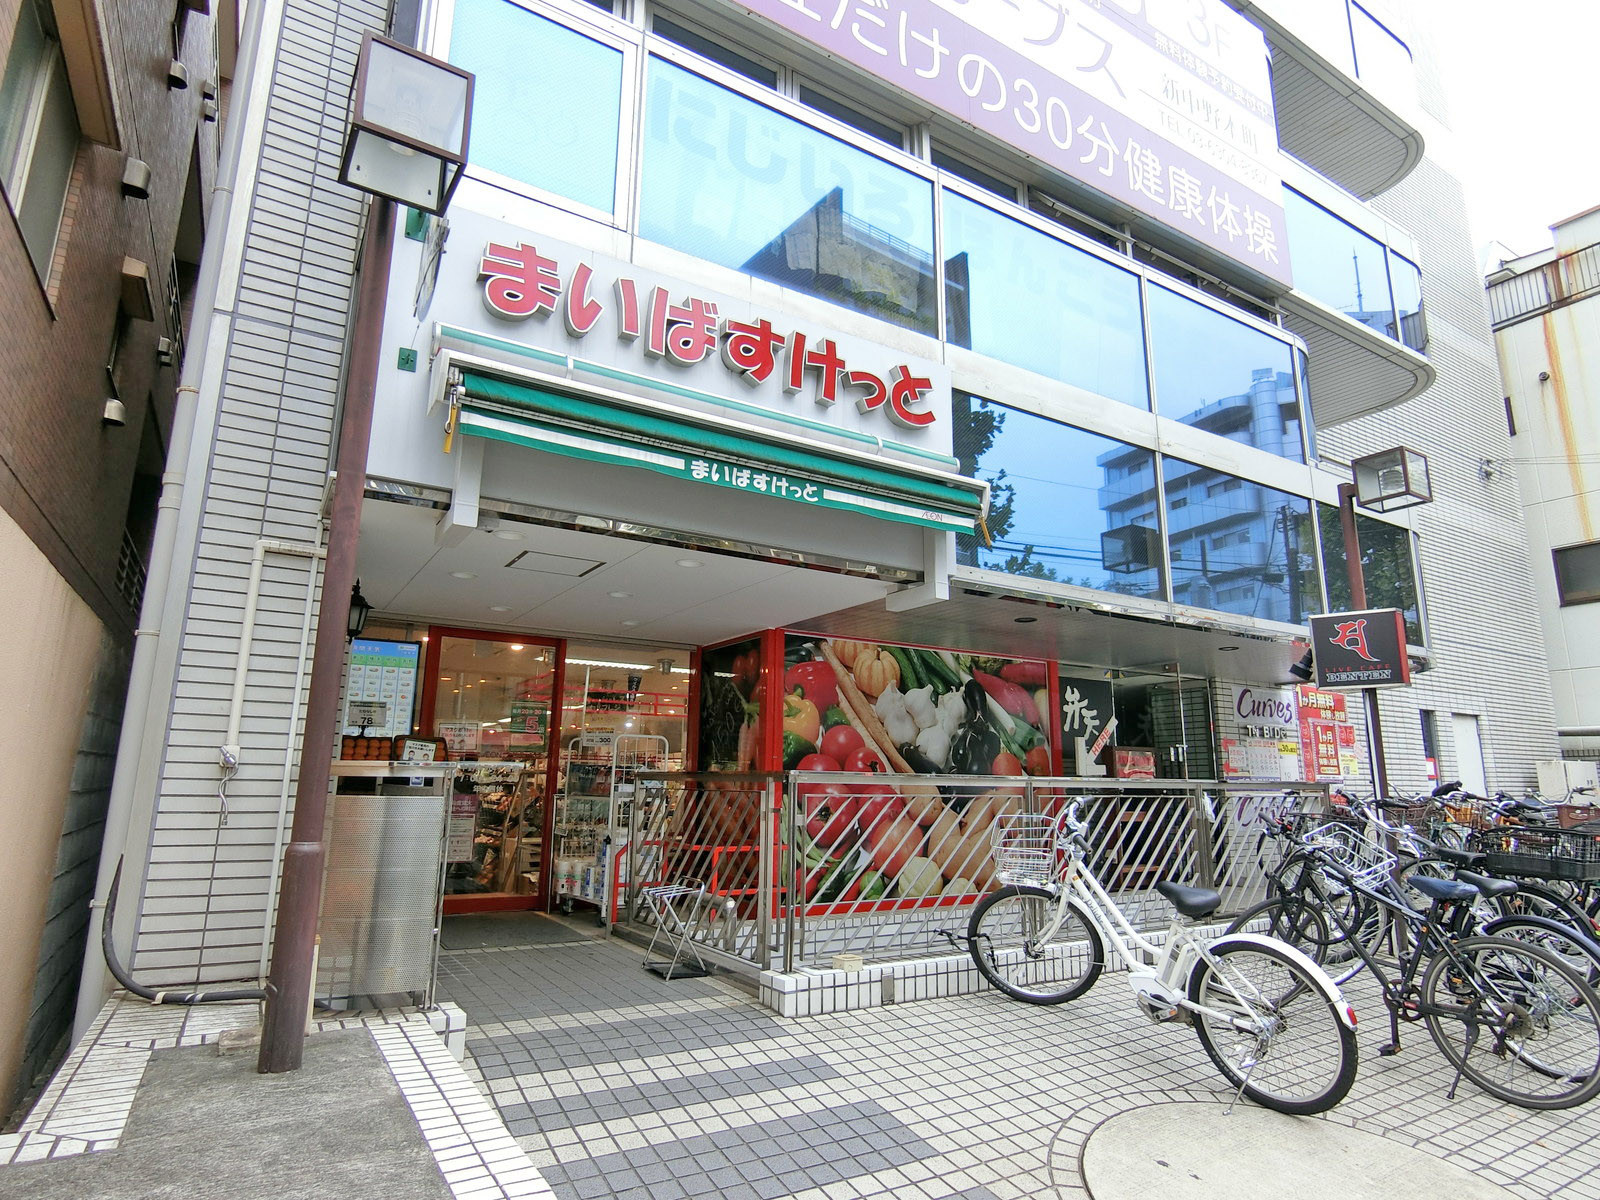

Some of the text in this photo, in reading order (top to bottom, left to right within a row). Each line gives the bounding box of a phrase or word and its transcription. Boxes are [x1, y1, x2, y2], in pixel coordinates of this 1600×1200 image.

[650, 75, 918, 242] にじいろ
[477, 241, 936, 430] まいばすけっと
[690, 459, 819, 502] まいばすけっと
[1326, 669, 1392, 682] BENTEN
[1236, 688, 1293, 724] Curves
[1296, 685, 1335, 710] 1か月無料
[361, 717, 374, 725] 78
[1316, 726, 1334, 744] 1か月
[1091, 727, 1112, 757] HERE
